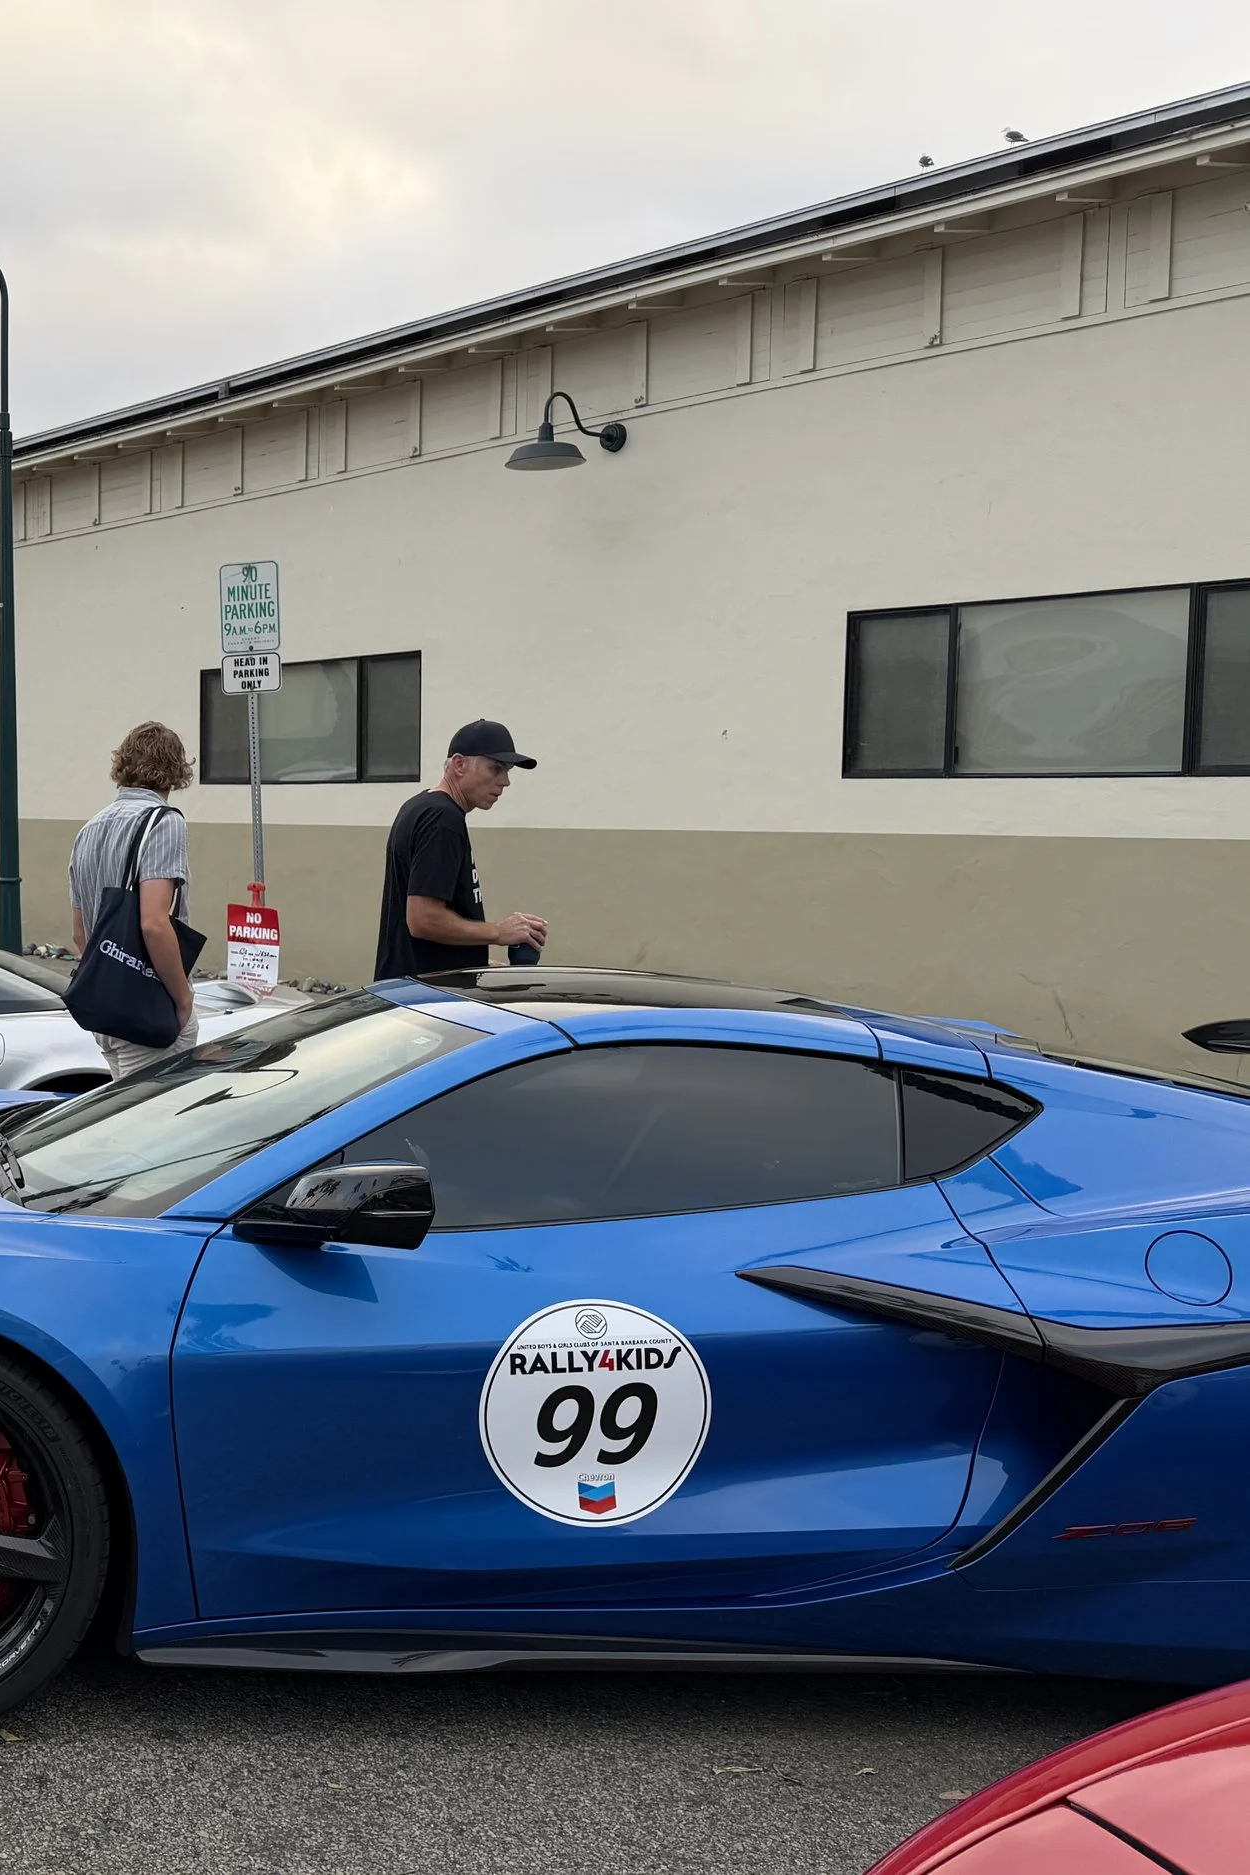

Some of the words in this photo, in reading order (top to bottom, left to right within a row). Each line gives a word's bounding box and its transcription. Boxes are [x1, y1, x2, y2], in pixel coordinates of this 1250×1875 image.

[241, 566, 258, 582] 90
[227, 583, 271, 602] MINUTE
[224, 601, 275, 620] PARKING
[234, 657, 256, 667] HEAD
[259, 656, 268, 665] IN
[233, 668, 270, 678] PARKING
[241, 680, 262, 690] ONLY
[246, 912, 262, 924] NO
[229, 925, 278, 940] PARKING
[509, 1346, 681, 1375] RALLY4KIDS
[534, 1382, 658, 1468] 99
[578, 1473, 615, 1481] Chevron
[1052, 1517, 1198, 1539] Z06
